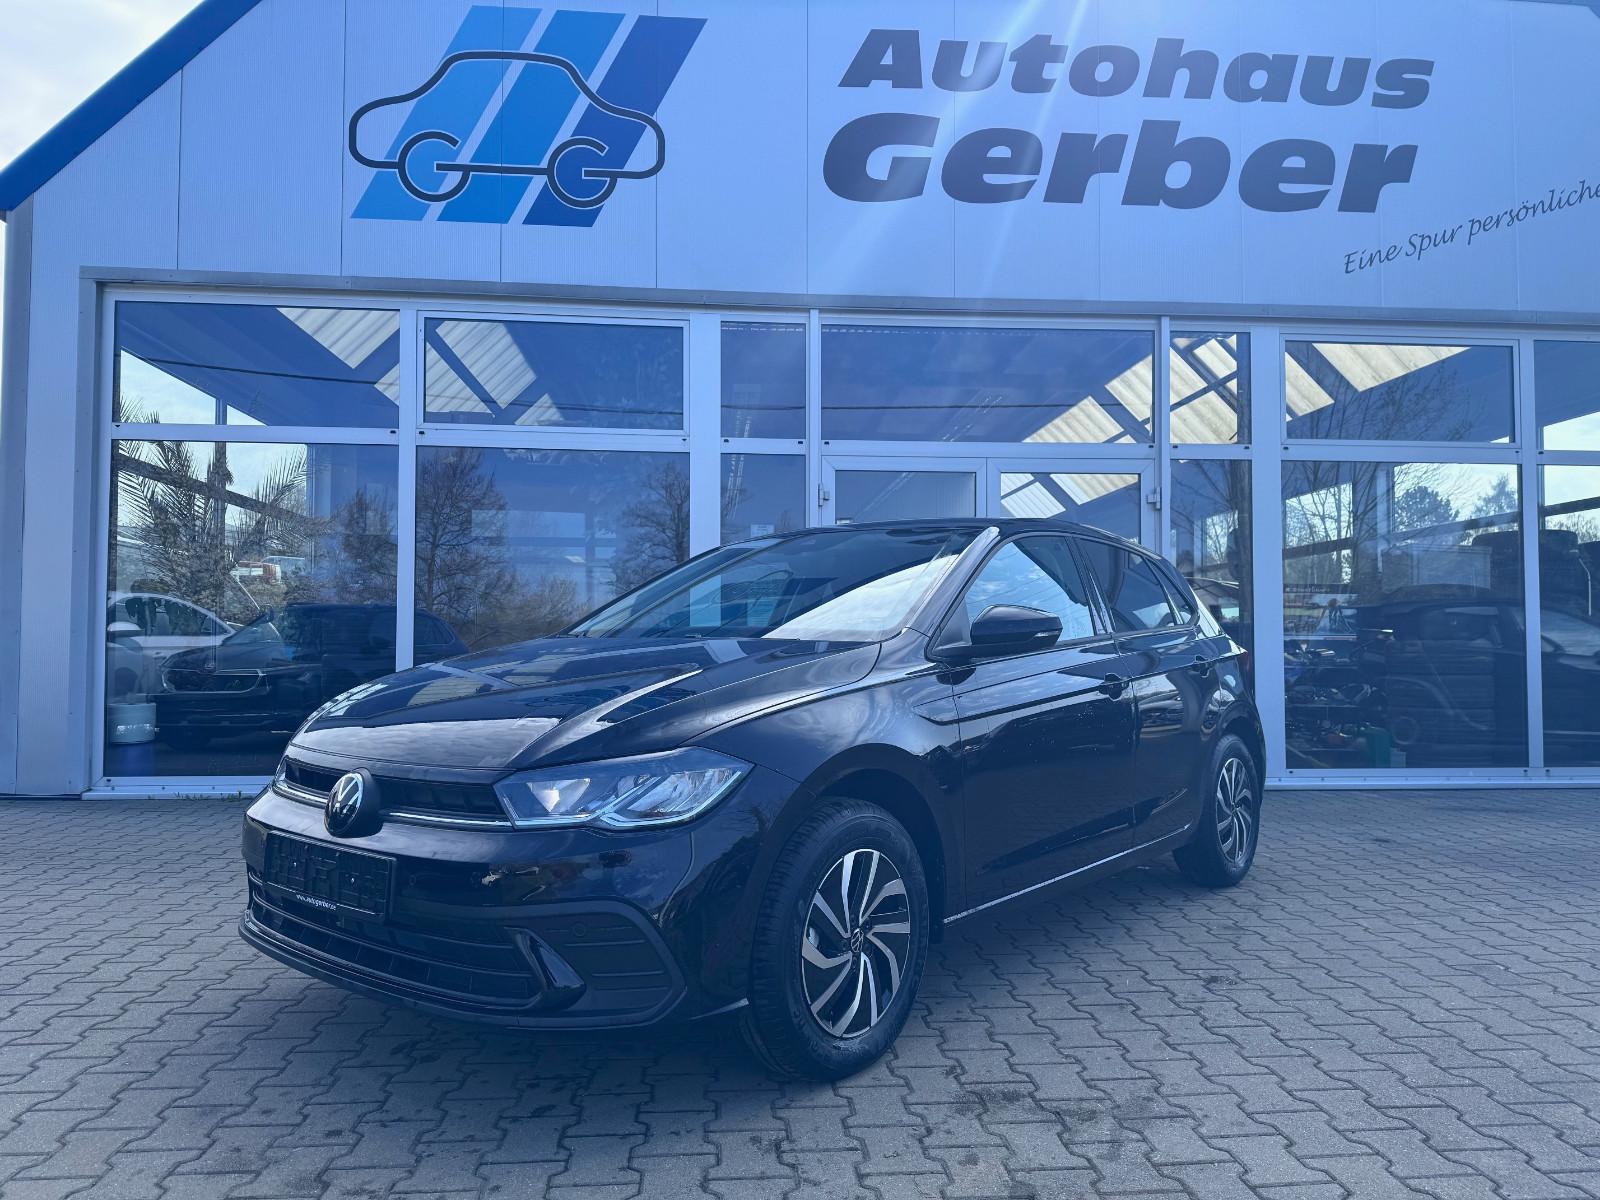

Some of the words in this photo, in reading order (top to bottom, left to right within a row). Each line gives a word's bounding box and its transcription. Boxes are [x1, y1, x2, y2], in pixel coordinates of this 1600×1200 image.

[838, 29, 1434, 109] Autohaus
[823, 112, 1418, 214] Gerber
[1343, 244, 1402, 274] Eine
[1405, 224, 1463, 261] Spur
